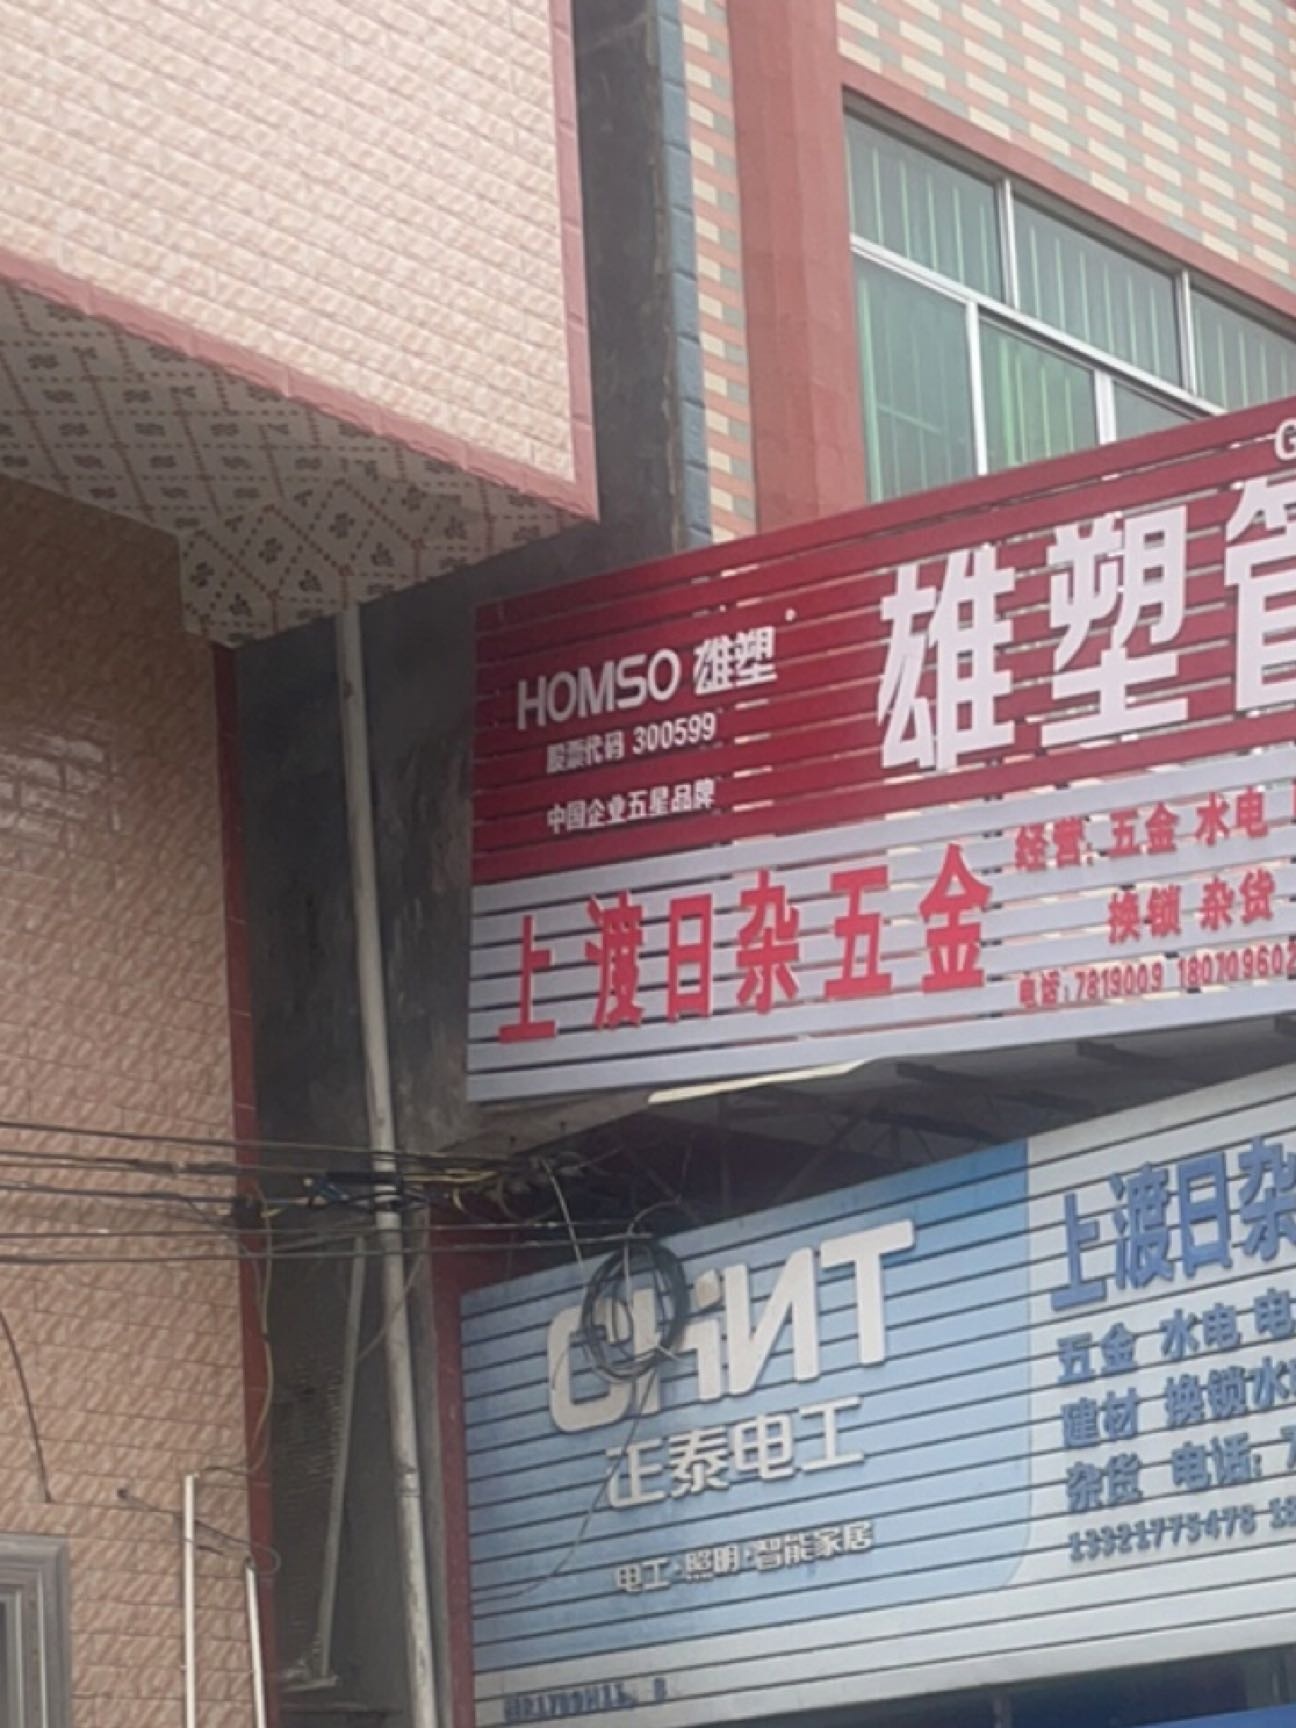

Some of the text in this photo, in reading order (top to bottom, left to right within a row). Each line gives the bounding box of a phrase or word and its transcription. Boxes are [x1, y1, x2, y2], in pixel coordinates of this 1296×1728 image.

[516, 626, 777, 730] HOMSO 雄塑
[632, 712, 716, 755] 300599
[547, 778, 715, 834] 中国企业五星品牌
[1195, 785, 1268, 845] 水电
[1056, 1322, 1138, 1385] 五金
[1160, 1301, 1241, 1361] 水电
[1061, 1388, 1140, 1449] 建材
[605, 1397, 867, 1509] 正泰电工
[1066, 1453, 1144, 1514] 杂货
